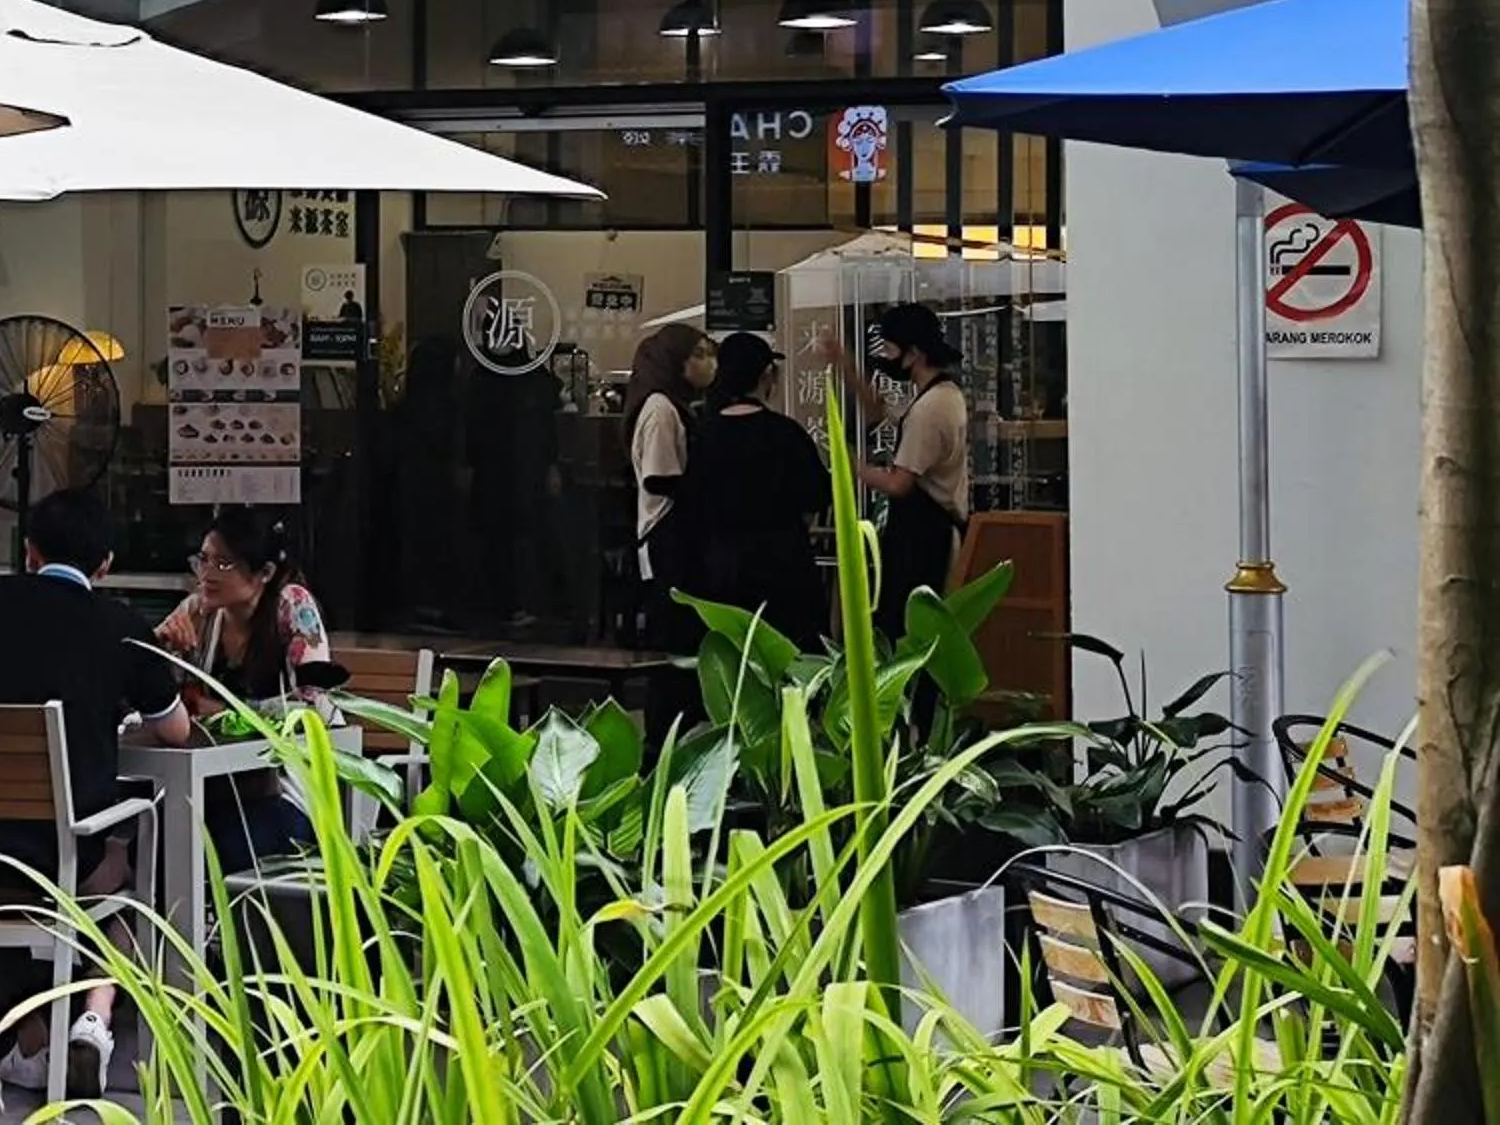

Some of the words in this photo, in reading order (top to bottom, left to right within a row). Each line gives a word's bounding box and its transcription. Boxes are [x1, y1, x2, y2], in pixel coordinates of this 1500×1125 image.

[209, 313, 245, 326] MENU
[485, 296, 537, 350] 源
[1265, 331, 1307, 345] ARANG
[1310, 331, 1373, 345] MEROKOK
